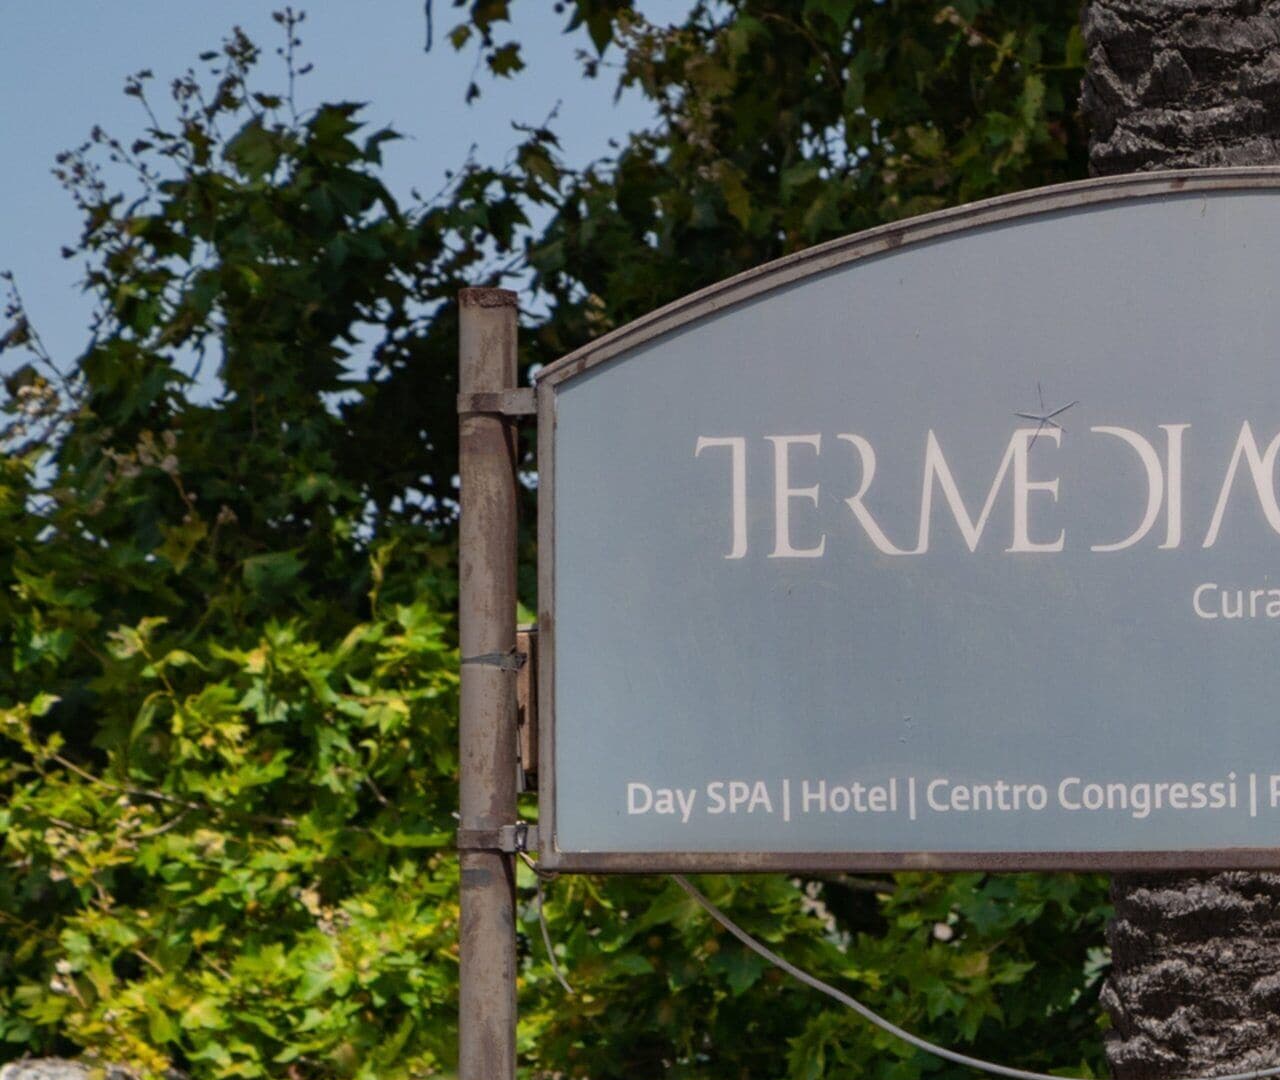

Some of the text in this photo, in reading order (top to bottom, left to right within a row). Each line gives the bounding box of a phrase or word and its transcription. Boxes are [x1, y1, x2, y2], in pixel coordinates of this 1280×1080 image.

[626, 782, 698, 823] Day
[706, 780, 773, 815] SPA
[801, 777, 898, 814] Hotel
[926, 777, 1049, 813] Centro
[1057, 771, 1238, 819] Congressi
